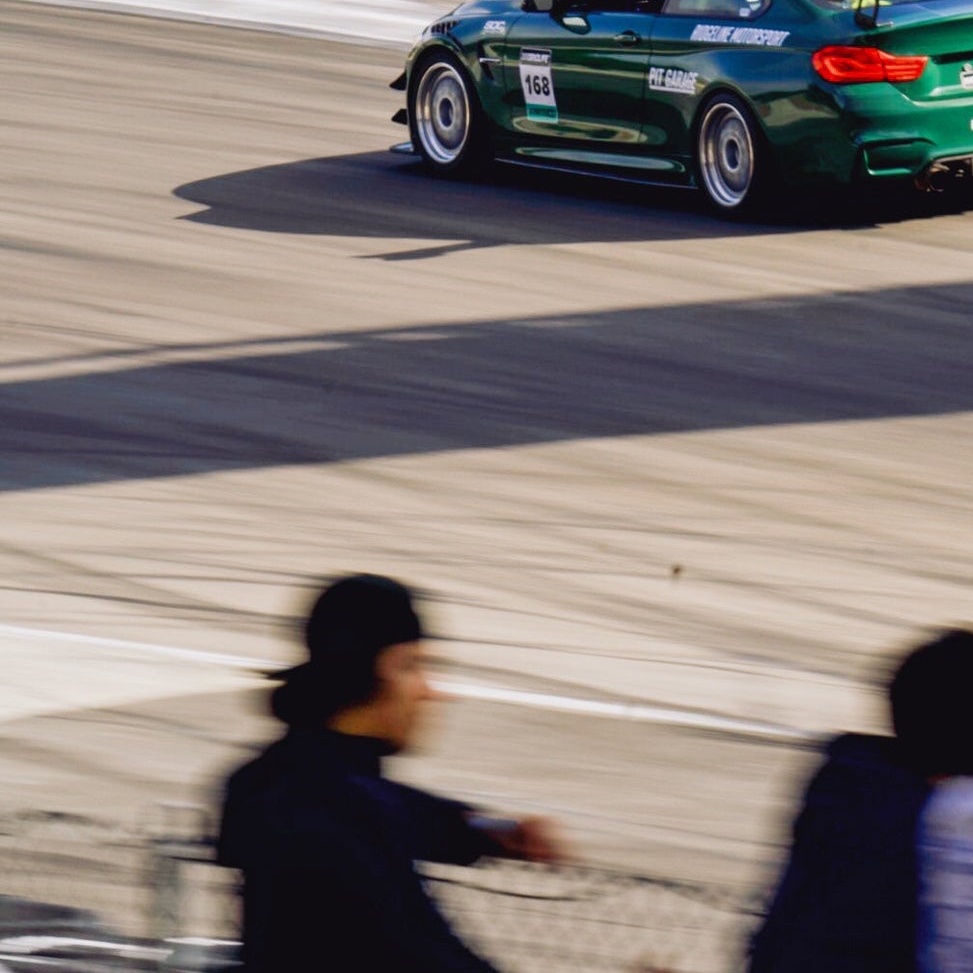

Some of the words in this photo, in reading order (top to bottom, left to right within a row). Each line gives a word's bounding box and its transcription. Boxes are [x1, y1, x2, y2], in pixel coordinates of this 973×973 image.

[525, 74, 551, 97] 168
[648, 67, 665, 86] PIT
[665, 69, 699, 90] GARAGE
